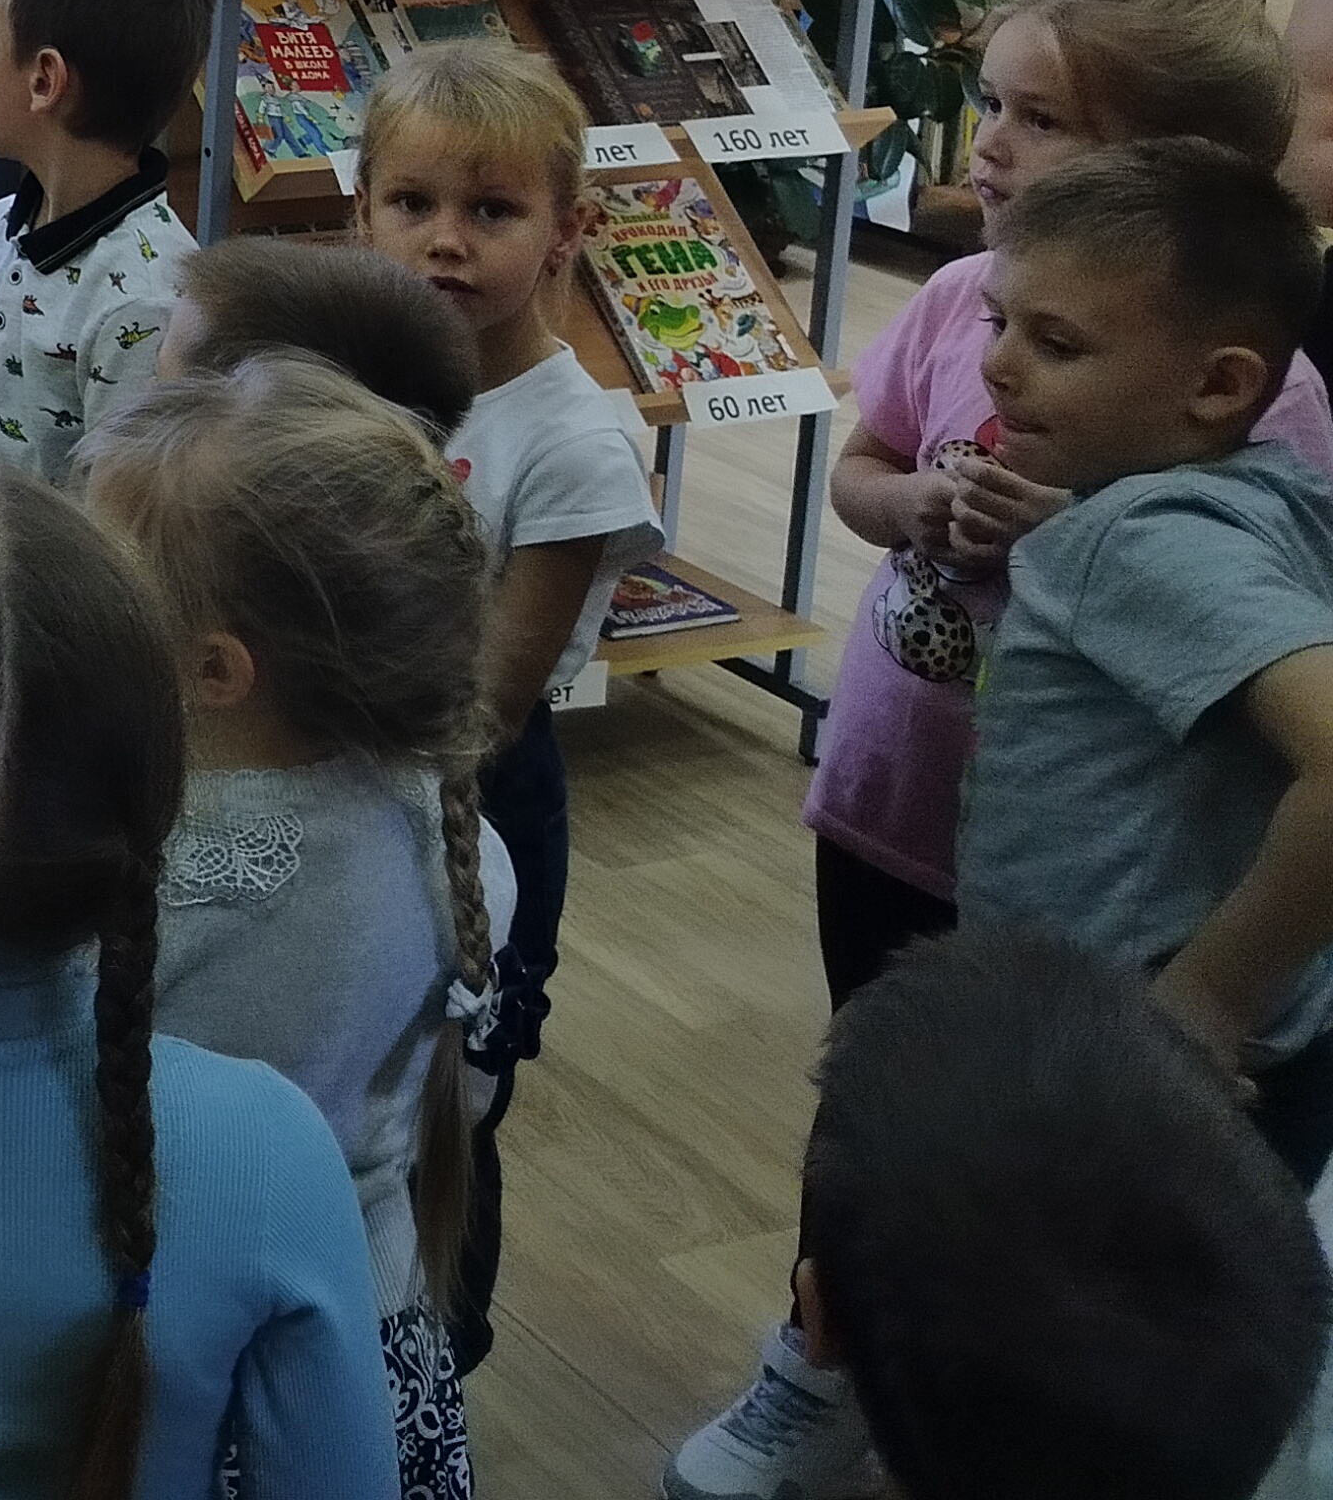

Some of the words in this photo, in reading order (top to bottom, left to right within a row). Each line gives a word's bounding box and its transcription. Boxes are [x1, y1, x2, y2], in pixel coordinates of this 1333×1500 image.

[275, 31, 317, 45] ВИТЯ
[270, 45, 334, 59] МАЛЕЕВ
[294, 60, 330, 70] ШКОЛЕ
[301, 71, 330, 80] ДОМА
[713, 127, 763, 153] 160
[769, 126, 811, 148] лет
[595, 141, 639, 164] лет
[611, 224, 688, 243] КРОКОДИЛ
[611, 240, 718, 278] ГЕНА
[648, 279, 670, 291] ЕГО
[673, 271, 719, 291] ДРУЗЬЯ
[707, 395, 740, 422] 60
[746, 391, 789, 415] лет
[549, 684, 575, 705] ет
